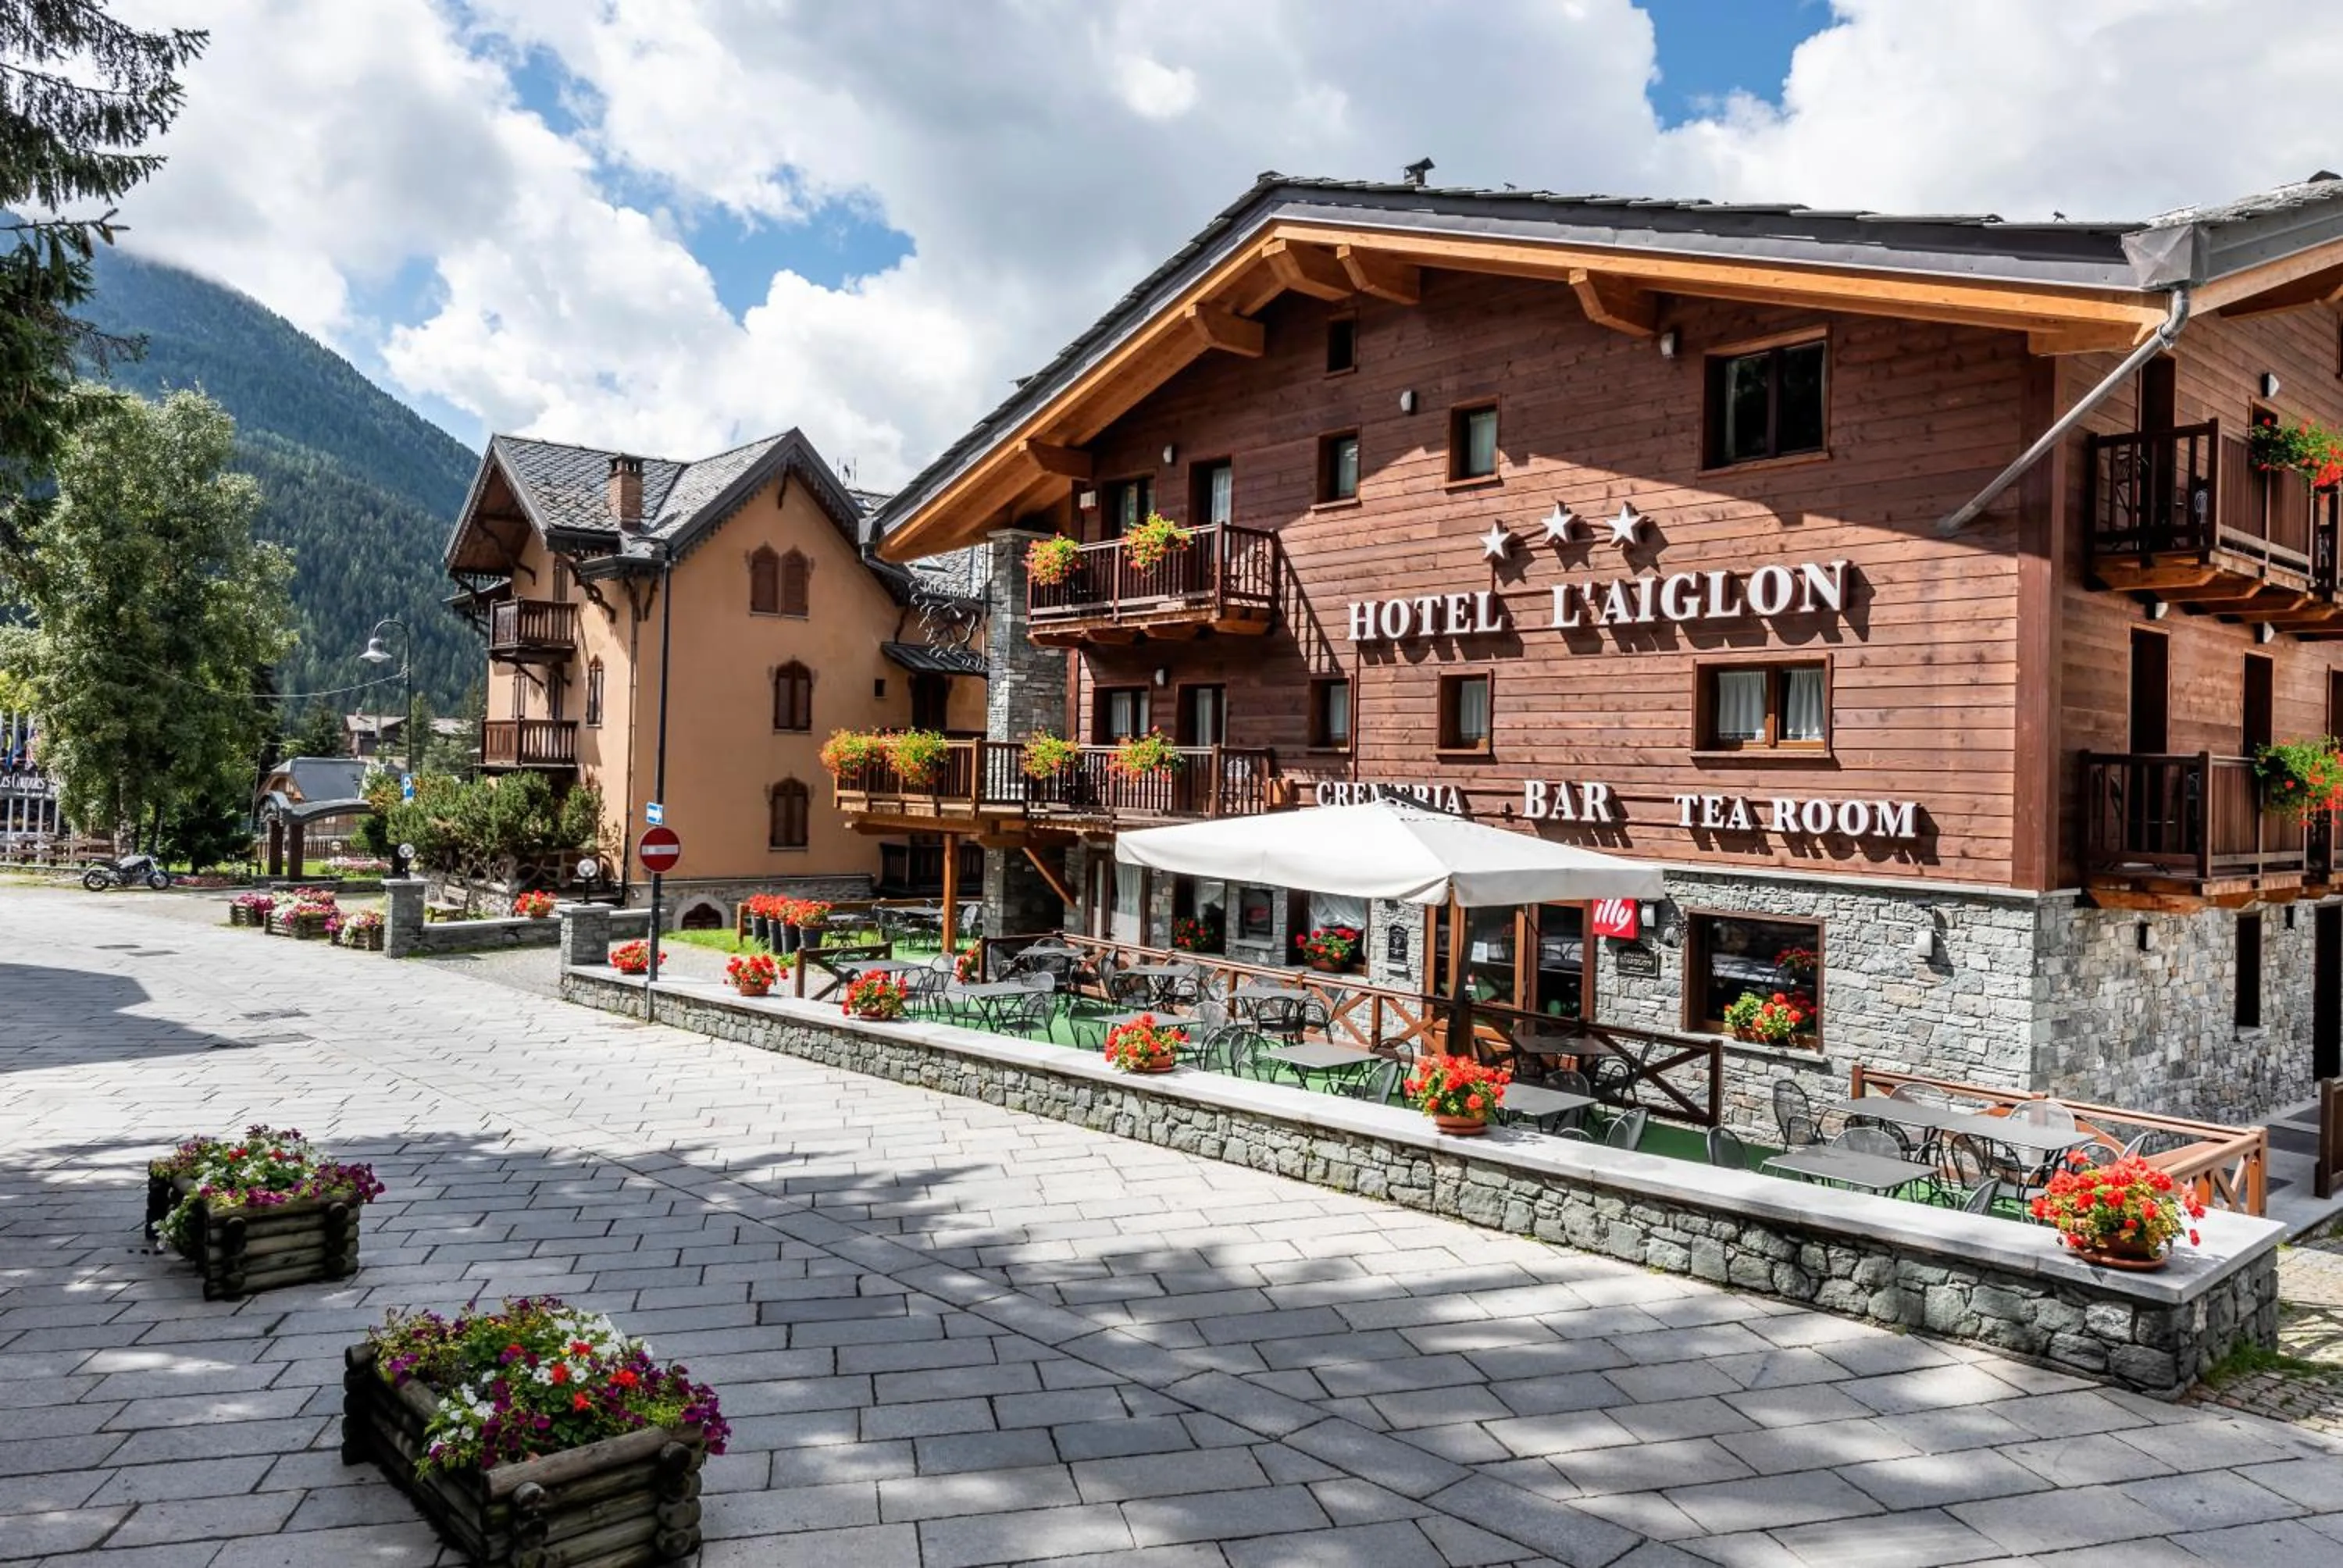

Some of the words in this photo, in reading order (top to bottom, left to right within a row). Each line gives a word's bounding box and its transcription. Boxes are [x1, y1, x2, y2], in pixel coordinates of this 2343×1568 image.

[1347, 590, 1504, 641] HOTEL
[1550, 561, 1849, 629] L'AIGLON
[403, 776, 412, 796] P
[1523, 780, 1614, 821] BAR
[1674, 795, 1752, 830] TEA
[1772, 798, 1917, 838] ROOM
[1595, 899, 1632, 932] illy
